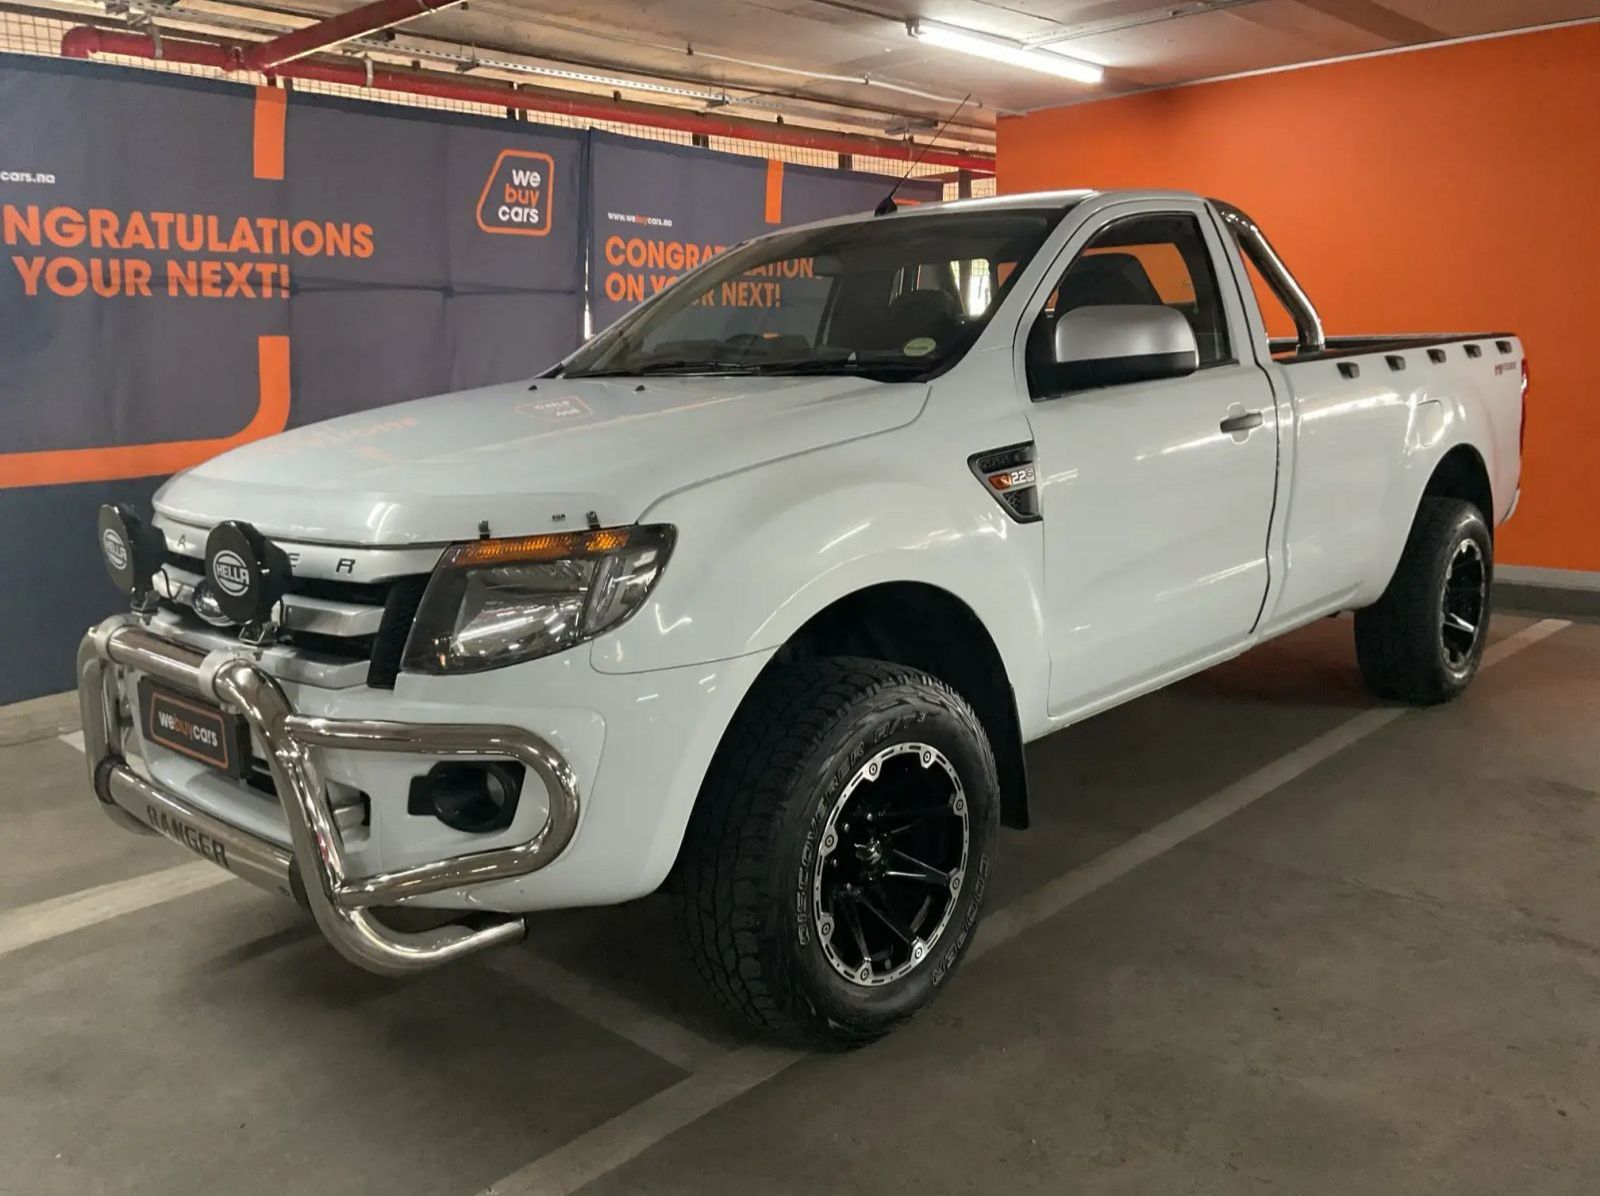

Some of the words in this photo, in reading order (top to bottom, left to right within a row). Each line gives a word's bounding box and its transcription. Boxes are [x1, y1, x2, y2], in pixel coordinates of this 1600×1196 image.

[504, 183, 540, 206] buy
[512, 168, 541, 187] we
[2, 204, 374, 258] NGRATULATIONS
[498, 204, 539, 224] cars
[12, 255, 152, 299] YOUR
[166, 259, 290, 299] NEXT!
[605, 272, 644, 303] ON
[722, 281, 781, 308] NEXT!
[216, 563, 250, 586] HELLA
[157, 709, 218, 748] webuycars
[147, 804, 230, 869] RANGER
